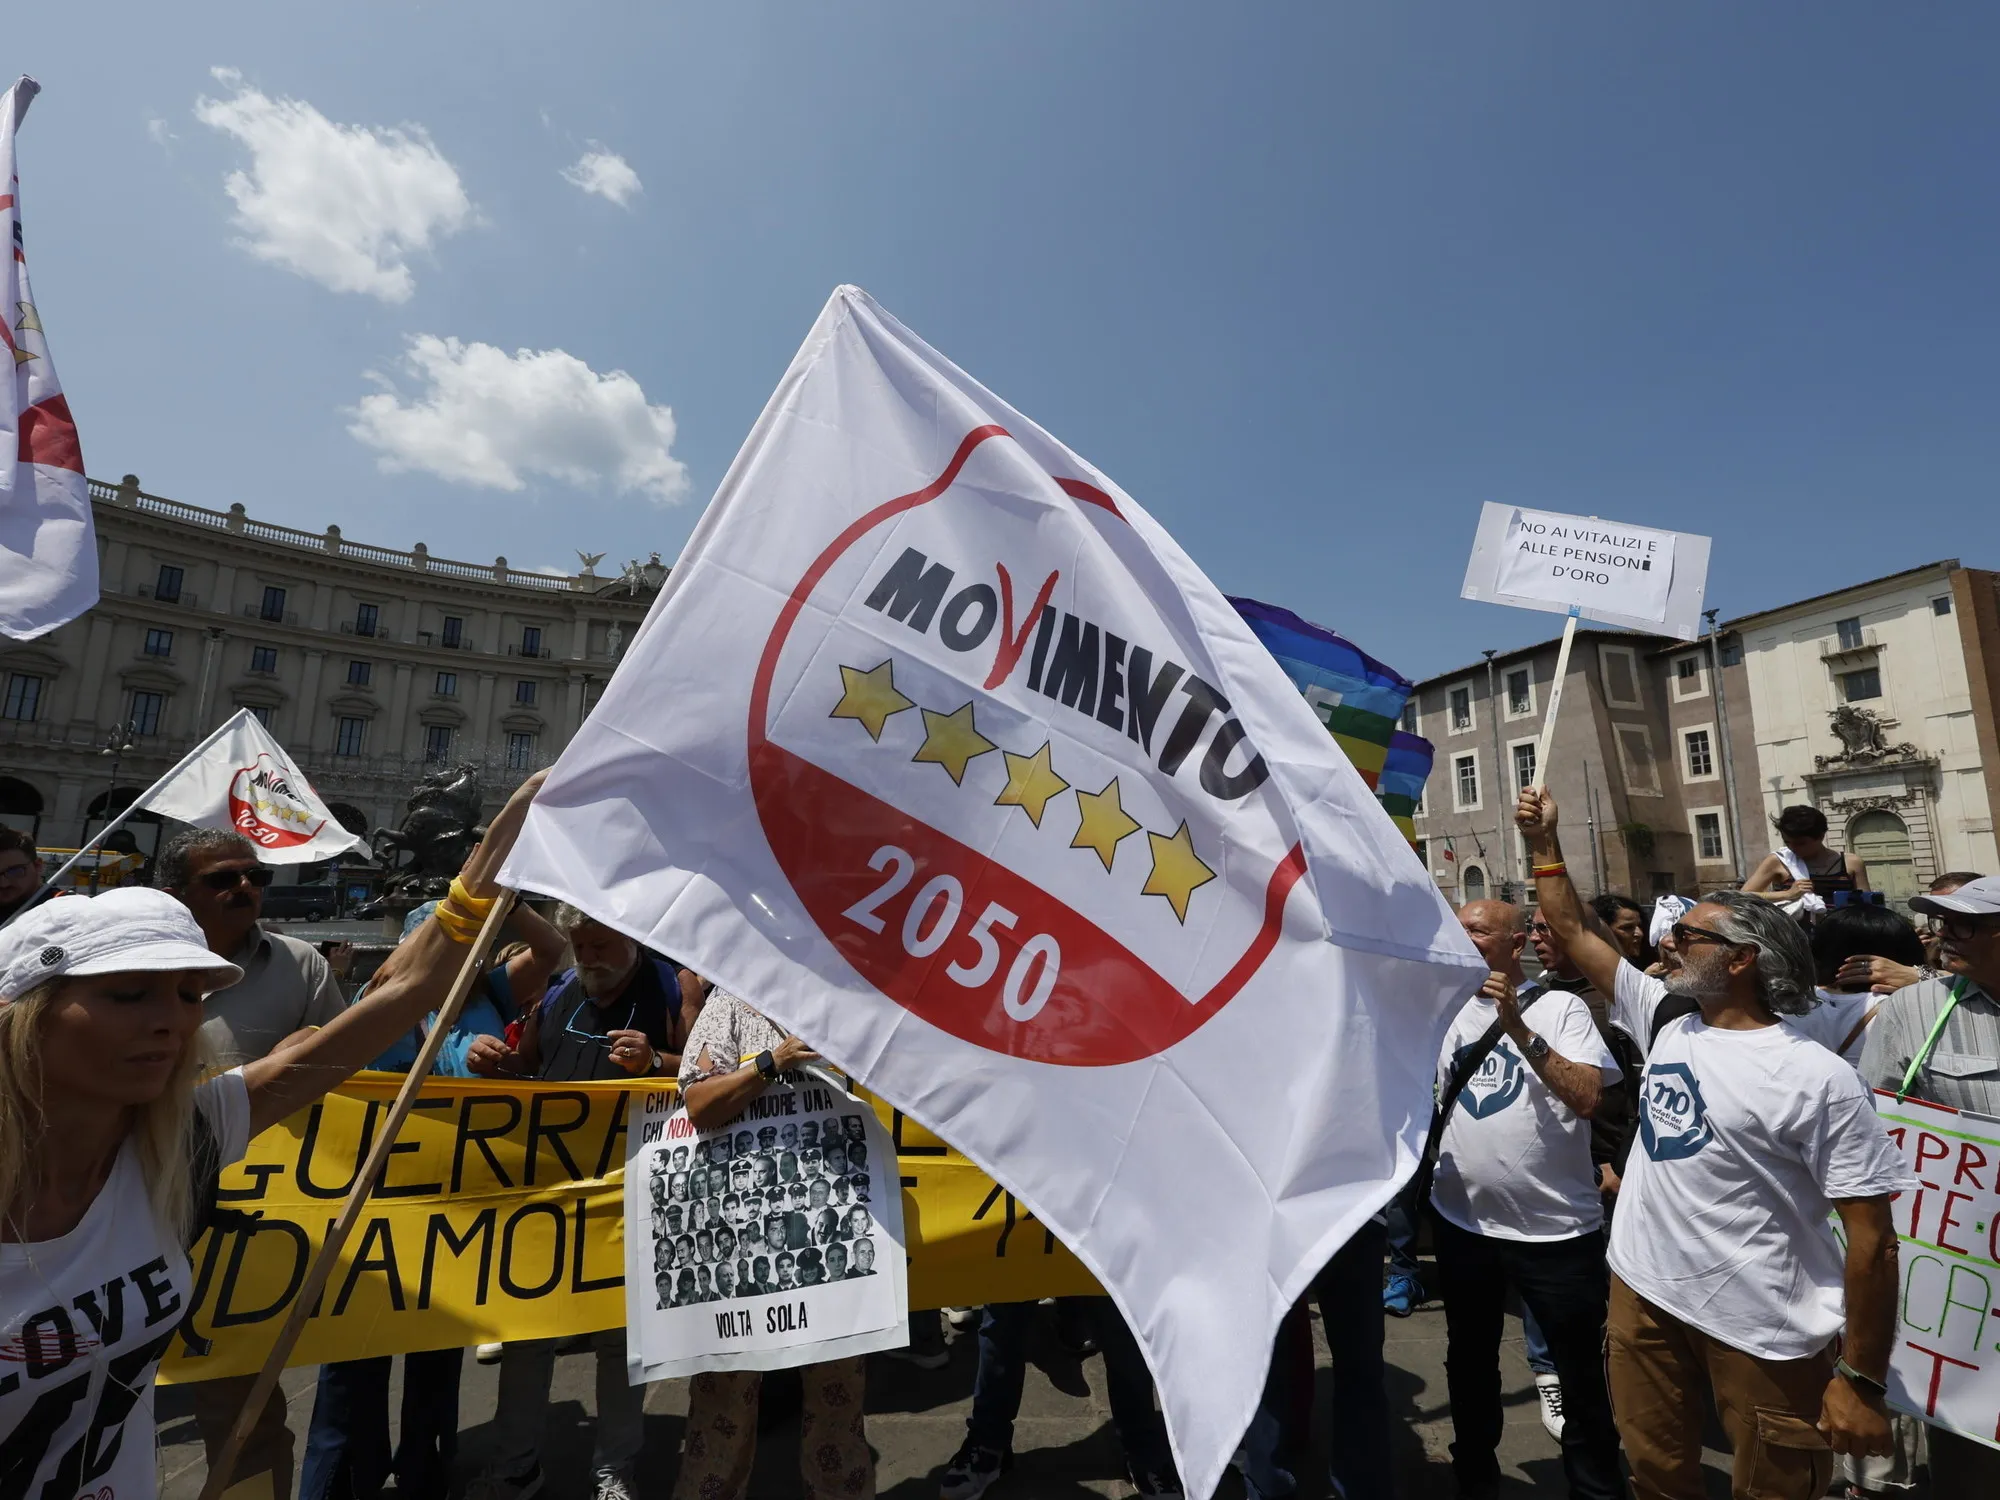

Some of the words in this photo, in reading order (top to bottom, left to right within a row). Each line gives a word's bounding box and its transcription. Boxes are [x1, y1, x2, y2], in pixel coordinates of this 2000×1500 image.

[1519, 540, 1558, 557] ALLE
[1521, 522, 1546, 536] NO
[1550, 526, 1568, 539] AI
[1574, 529, 1642, 550] VITALIZI
[1648, 540, 1657, 552] E
[1552, 565, 1610, 585] D'ORO
[864, 547, 1270, 800] MOVIMENTO
[841, 844, 1061, 1021] 2050
[642, 1120, 664, 1143] CHI
[666, 1117, 695, 1141] NON
[750, 1091, 798, 1120] MUORE
[803, 1088, 834, 1113] UNA
[645, 1091, 671, 1114] CHI
[0, 1254, 181, 1397] OVE
[715, 1309, 753, 1339] VOLTA
[766, 1301, 808, 1334] SOLA
